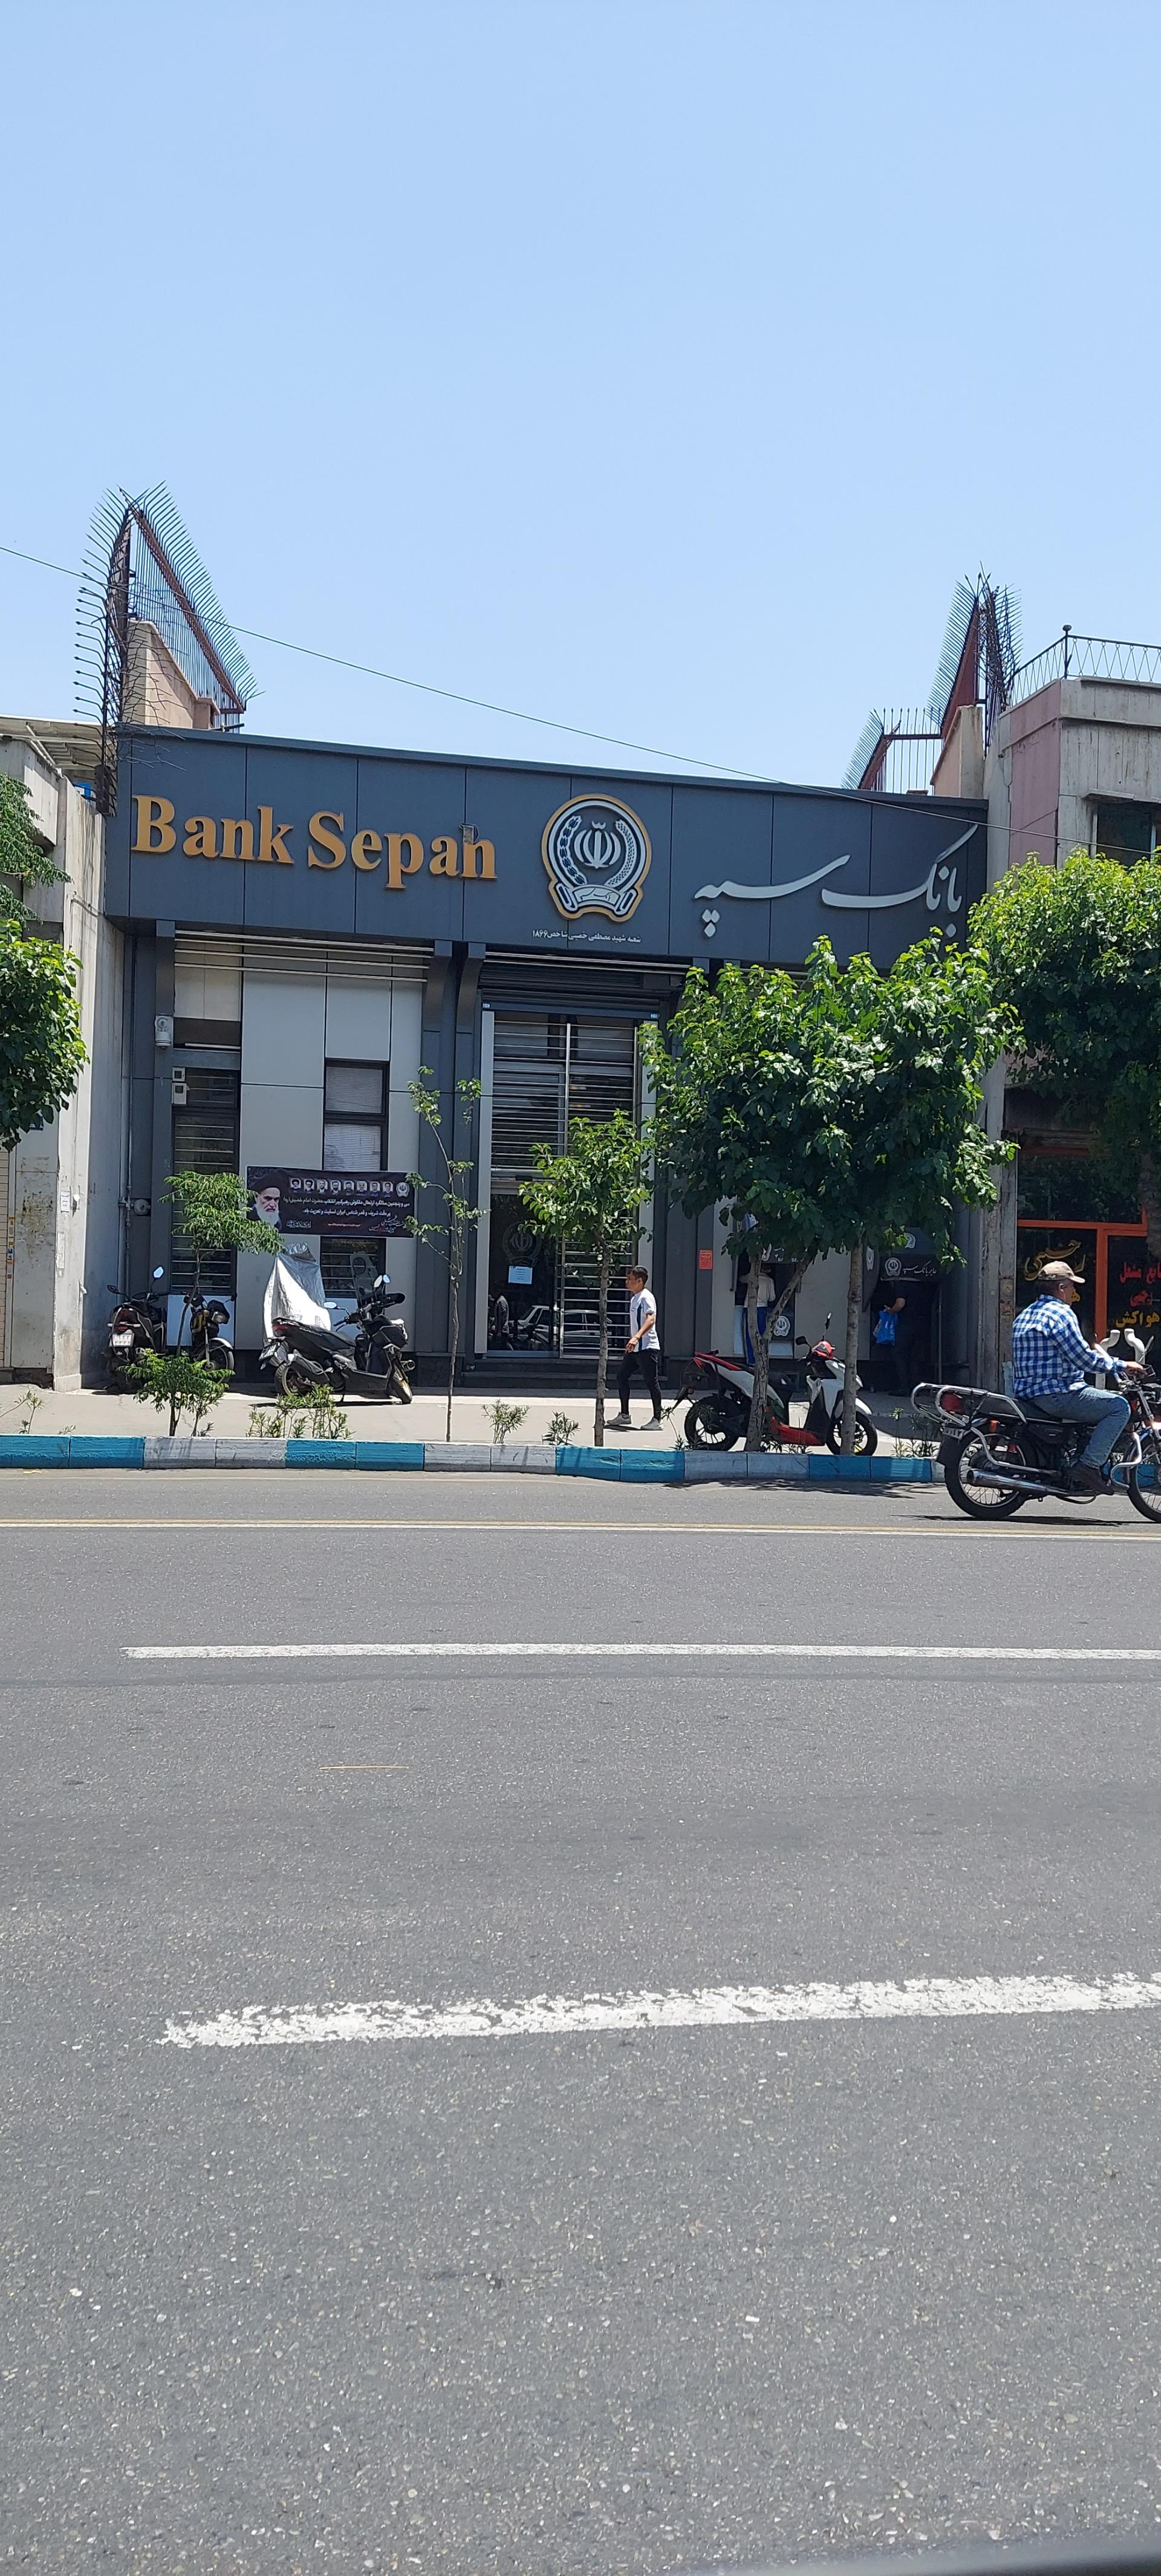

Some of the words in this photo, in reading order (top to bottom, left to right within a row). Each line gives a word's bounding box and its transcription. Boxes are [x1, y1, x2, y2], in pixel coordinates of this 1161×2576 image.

[132, 795, 294, 864] Bank
[308, 810, 497, 890] Sepah
[694, 854, 850, 938] سپه
[822, 824, 978, 938] بانک
[568, 931, 587, 940] خمینی
[588, 931, 611, 942] مصطفی
[611, 934, 626, 943] شهید
